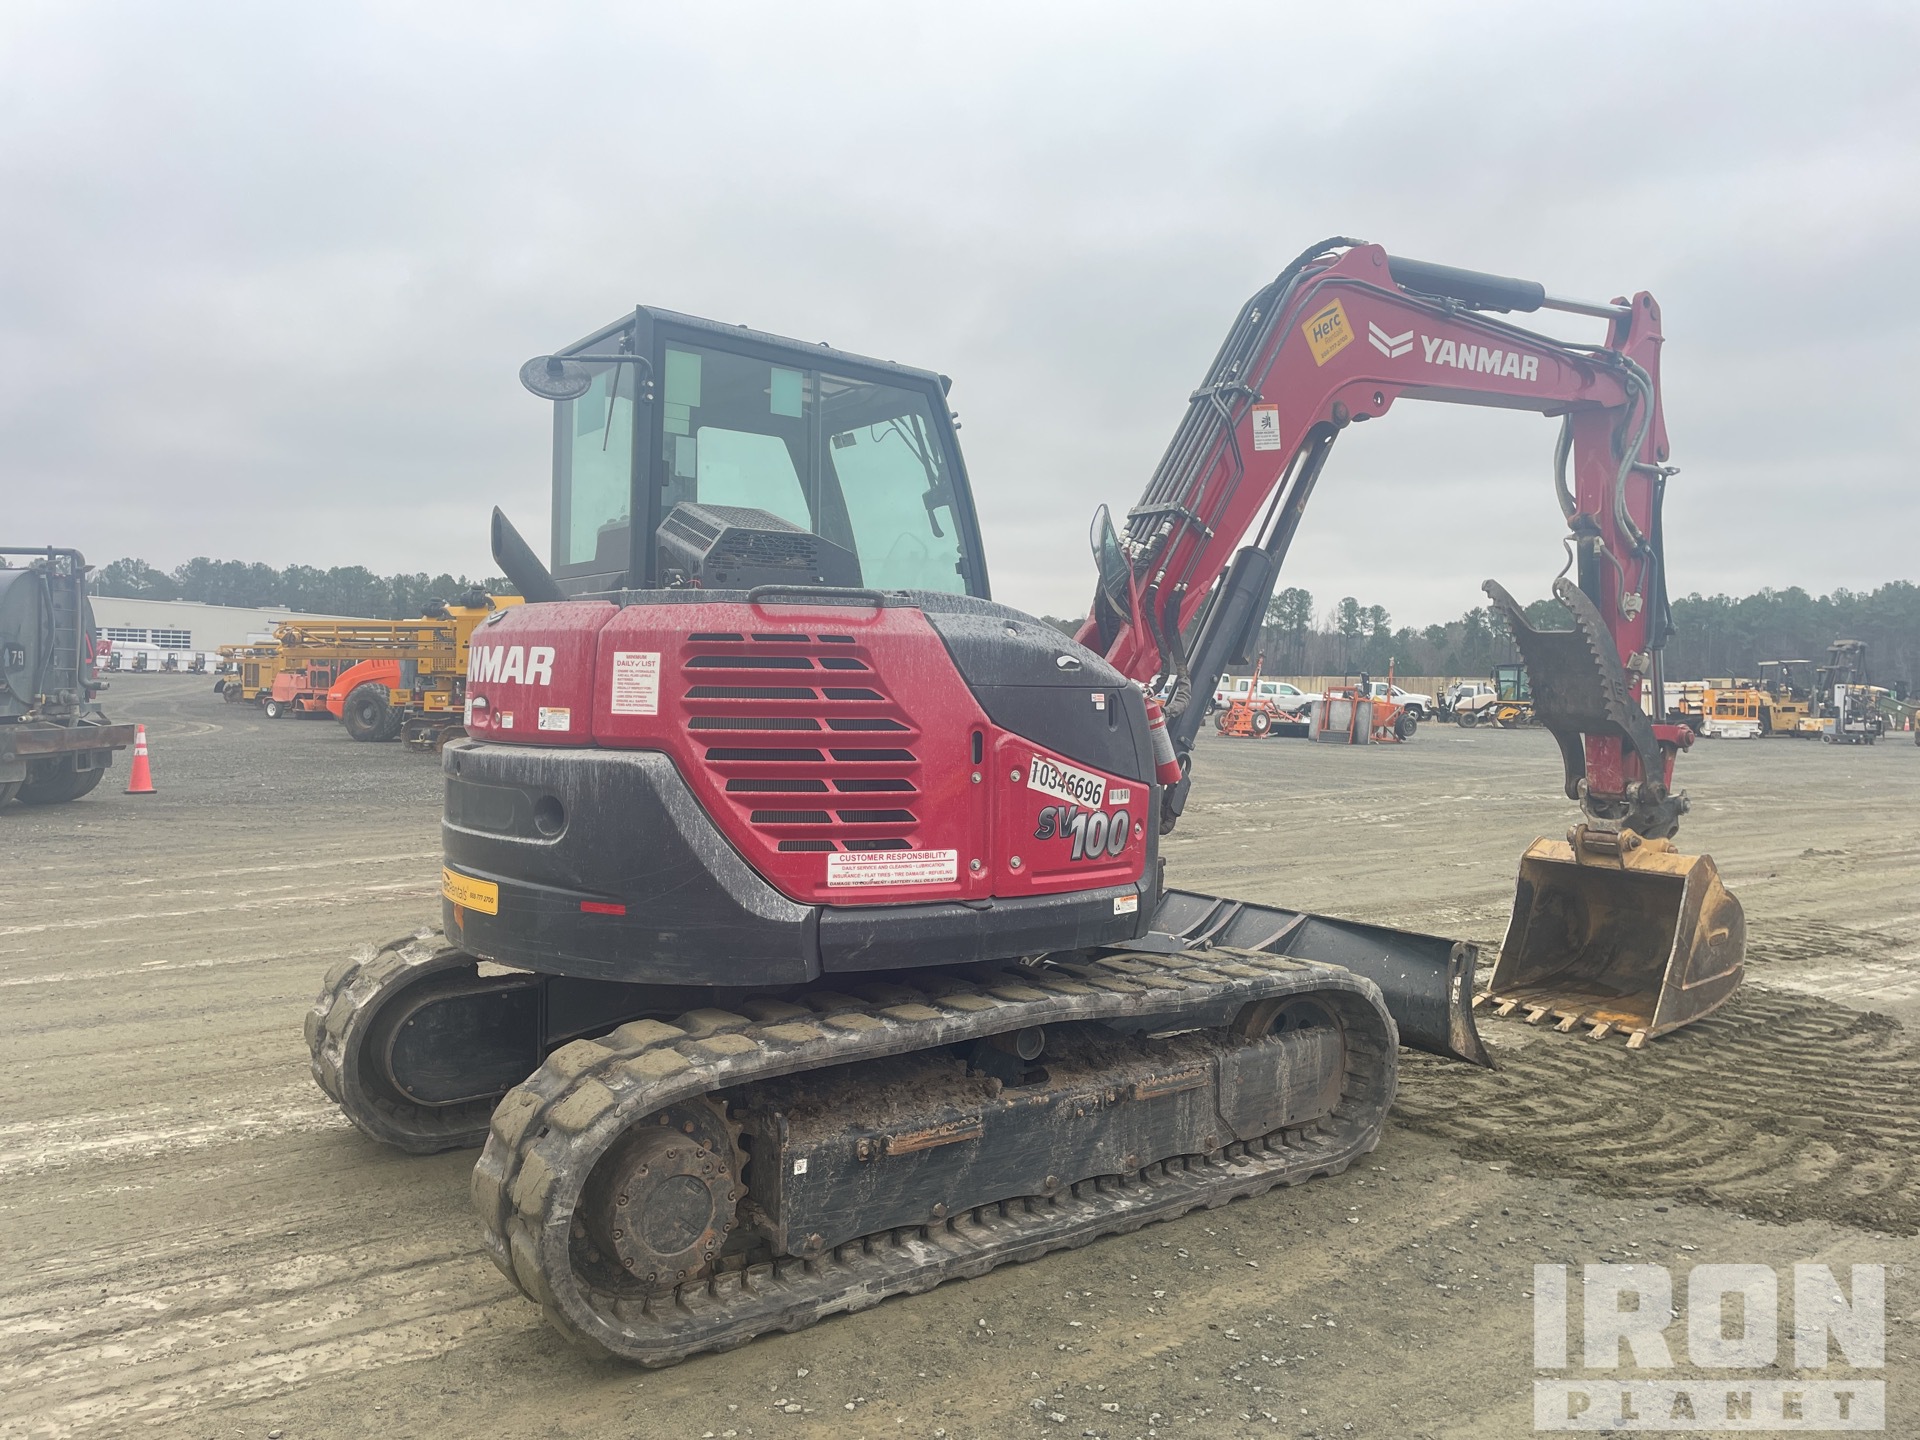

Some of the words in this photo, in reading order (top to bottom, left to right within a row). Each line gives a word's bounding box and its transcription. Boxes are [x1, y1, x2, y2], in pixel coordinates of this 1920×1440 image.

[1312, 313, 1341, 343] Herc
[1420, 334, 1539, 382] YANMAR
[467, 645, 556, 686] NMAR
[1031, 760, 1103, 805] 10346696
[839, 854, 885, 862] CUSTOMER
[886, 851, 947, 860] RESPONSIBILITY
